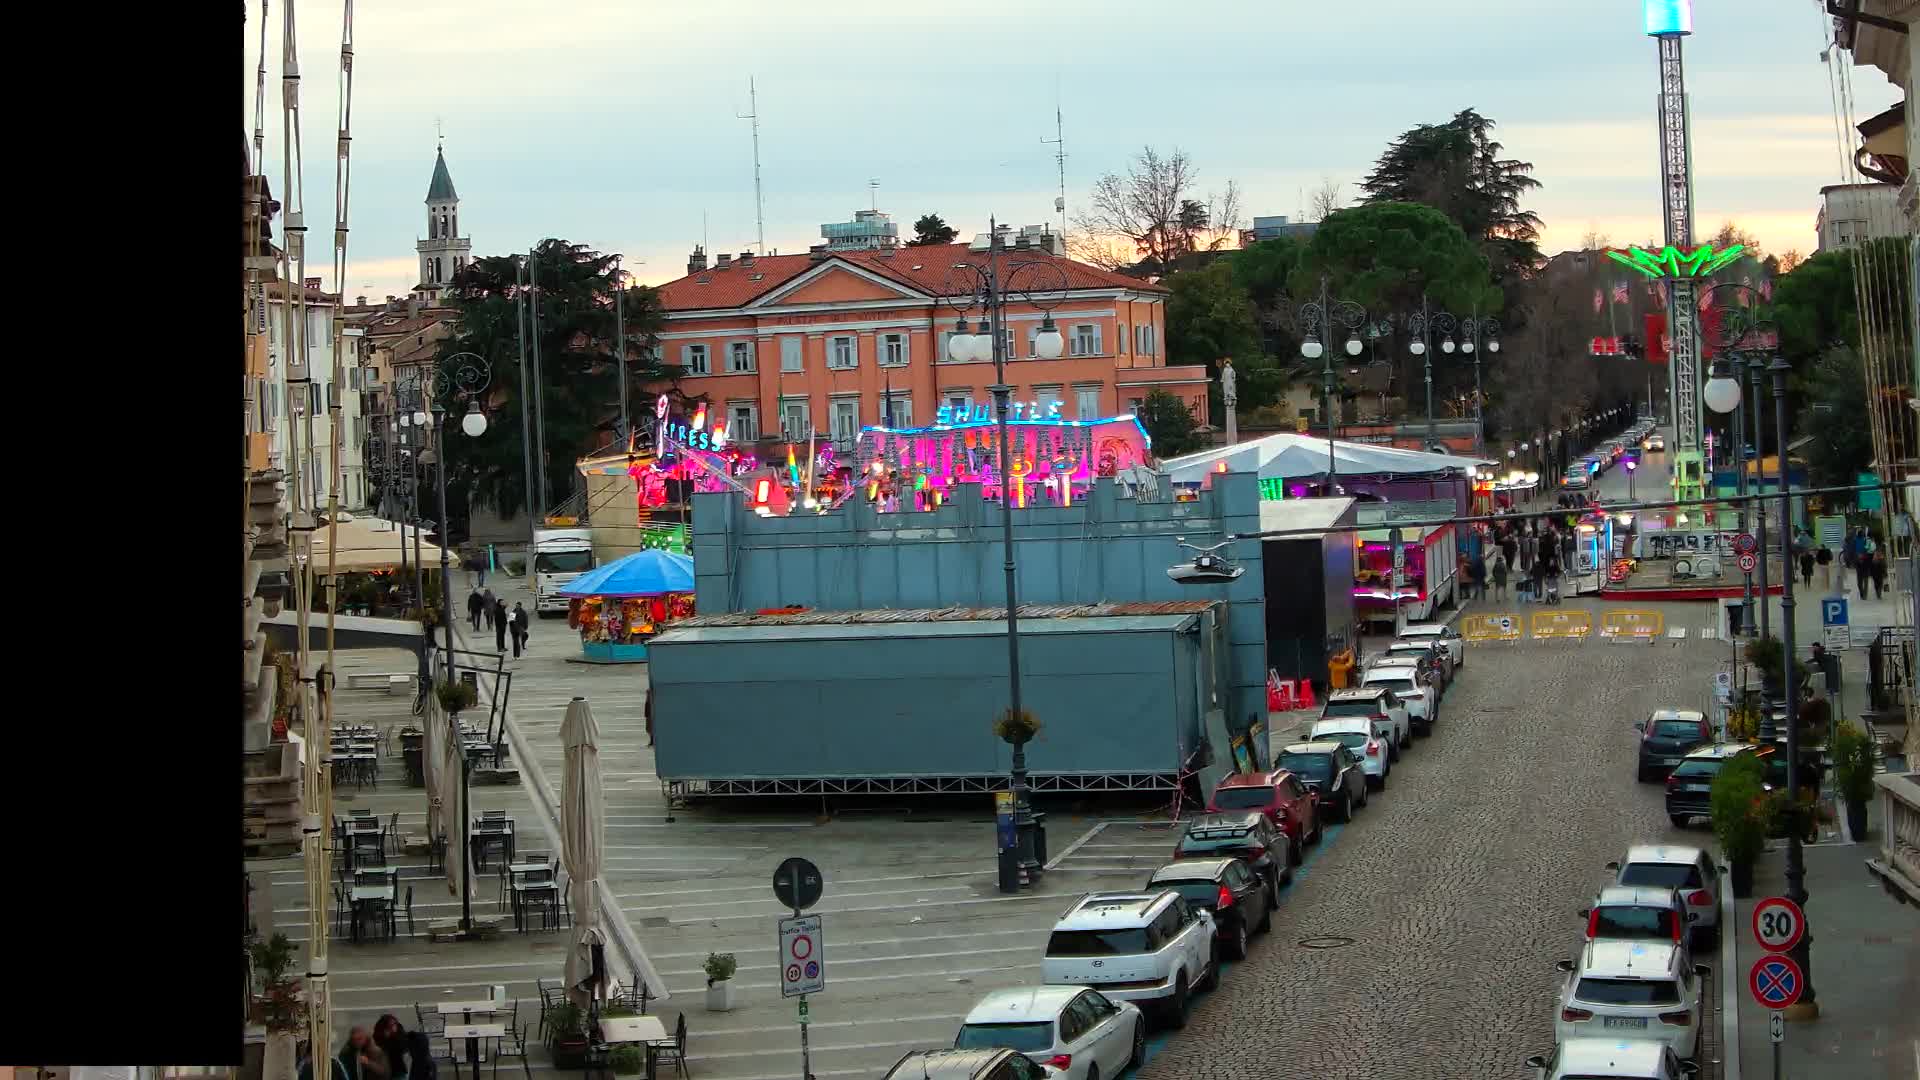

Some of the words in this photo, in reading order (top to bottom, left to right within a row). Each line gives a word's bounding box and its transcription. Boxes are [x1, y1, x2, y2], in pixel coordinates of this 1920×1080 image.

[936, 401, 1064, 424] SHUTLE
[1742, 557, 1752, 567] 20
[1828, 603, 1841, 621] P
[1763, 912, 1791, 937] 30
